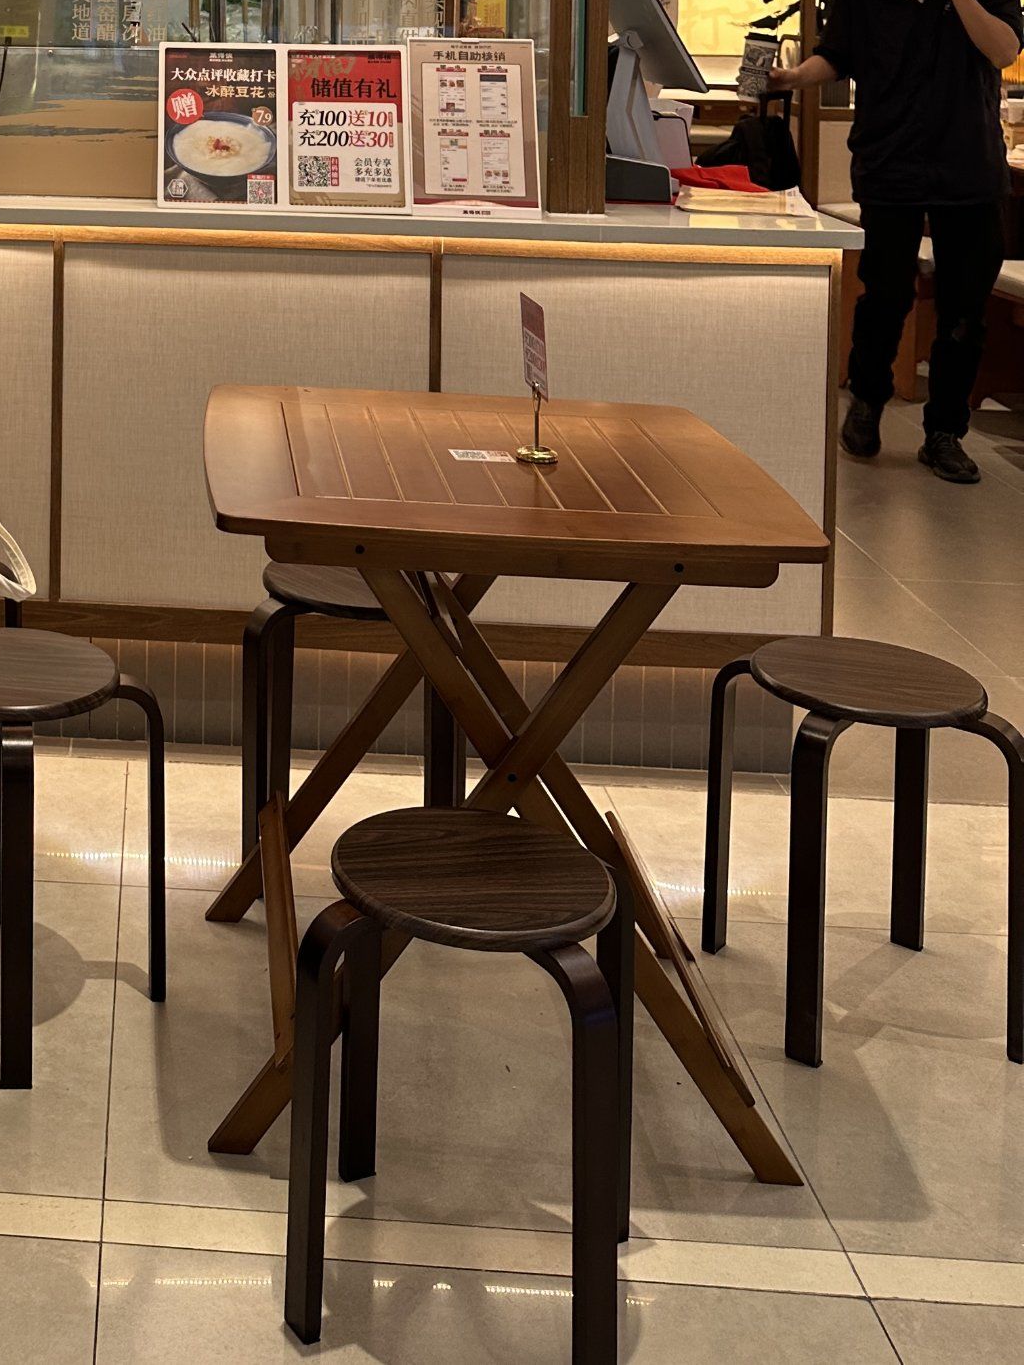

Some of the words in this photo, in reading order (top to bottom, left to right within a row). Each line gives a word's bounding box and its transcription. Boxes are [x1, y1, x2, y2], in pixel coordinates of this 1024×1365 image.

[433, 50, 506, 62] 手机自助核销
[170, 67, 276, 82] 大众点评收藏打卡
[206, 84, 266, 98] 冰醉豆花
[310, 77, 398, 99] 储值有礼
[171, 92, 198, 120] 赠
[254, 110, 272, 124] 7.9
[354, 157, 392, 167] 会员专享
[354, 167, 392, 177] 多充多送
